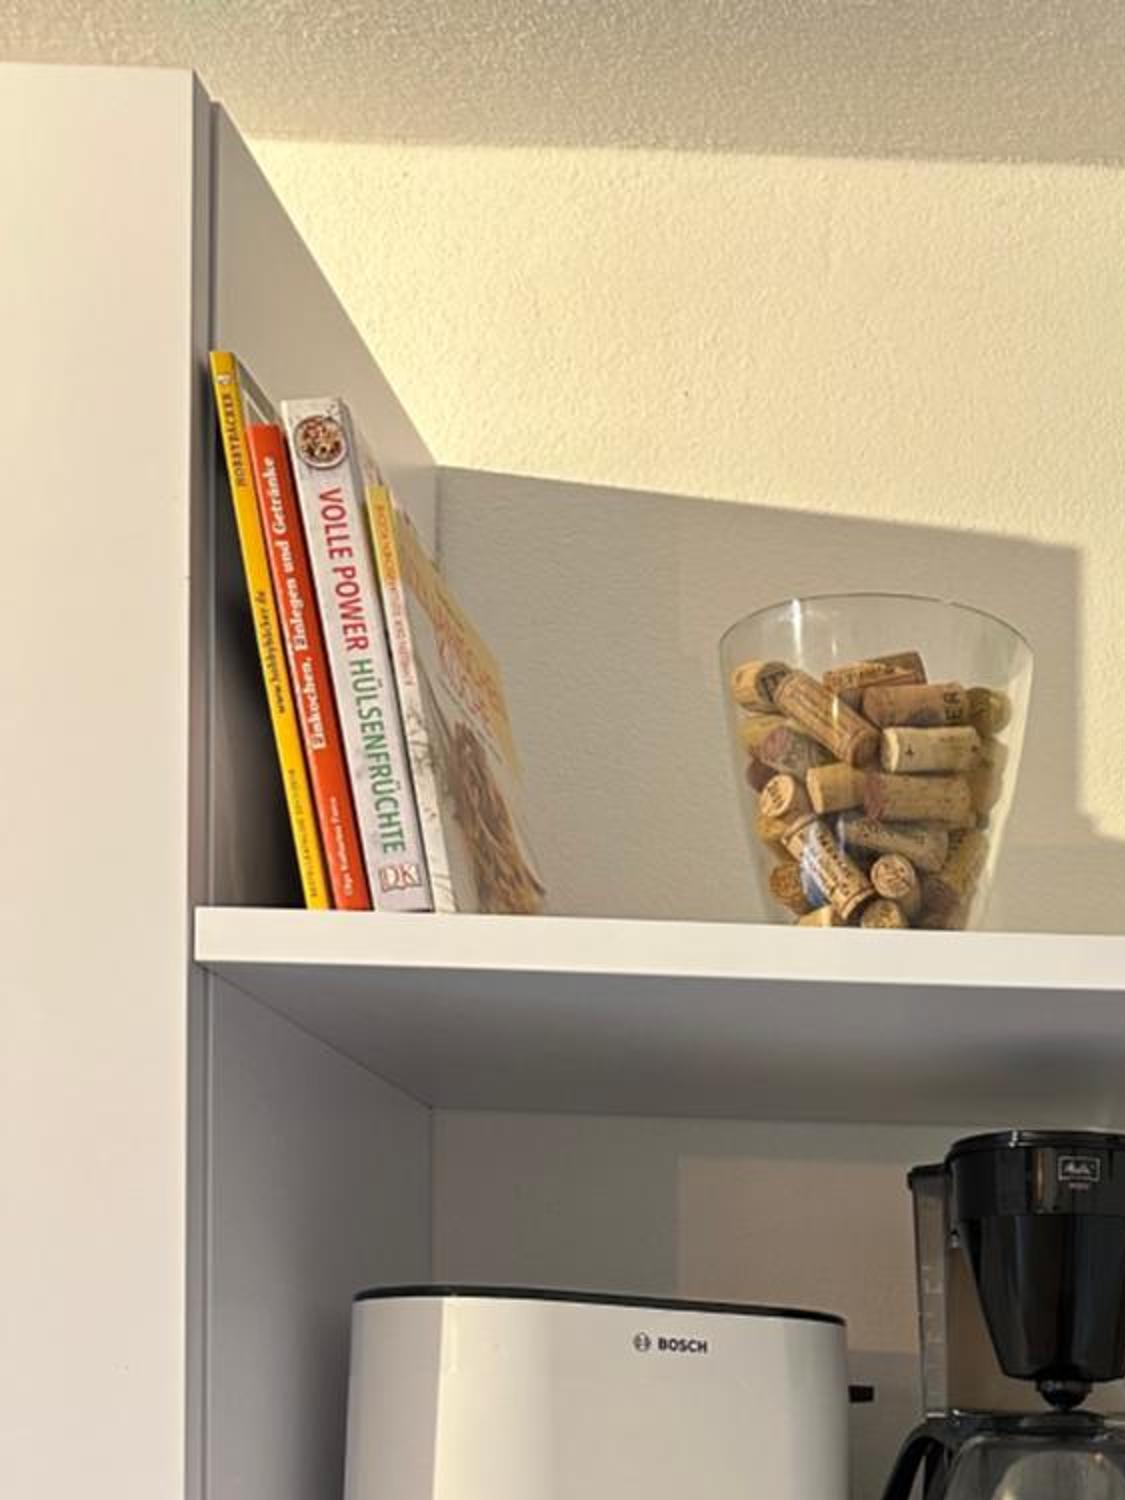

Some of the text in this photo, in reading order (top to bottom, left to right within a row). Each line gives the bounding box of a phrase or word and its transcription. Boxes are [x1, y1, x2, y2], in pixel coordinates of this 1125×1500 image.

[319, 488, 353, 560] VOLLE
[262, 456, 327, 750] Einkochen, Einlegen und Getränke
[332, 565, 370, 651] POWER
[350, 658, 406, 853] HÜLSENFRÜCHTE
[379, 864, 422, 892] DK
[657, 1337, 708, 1353] BOSCH
